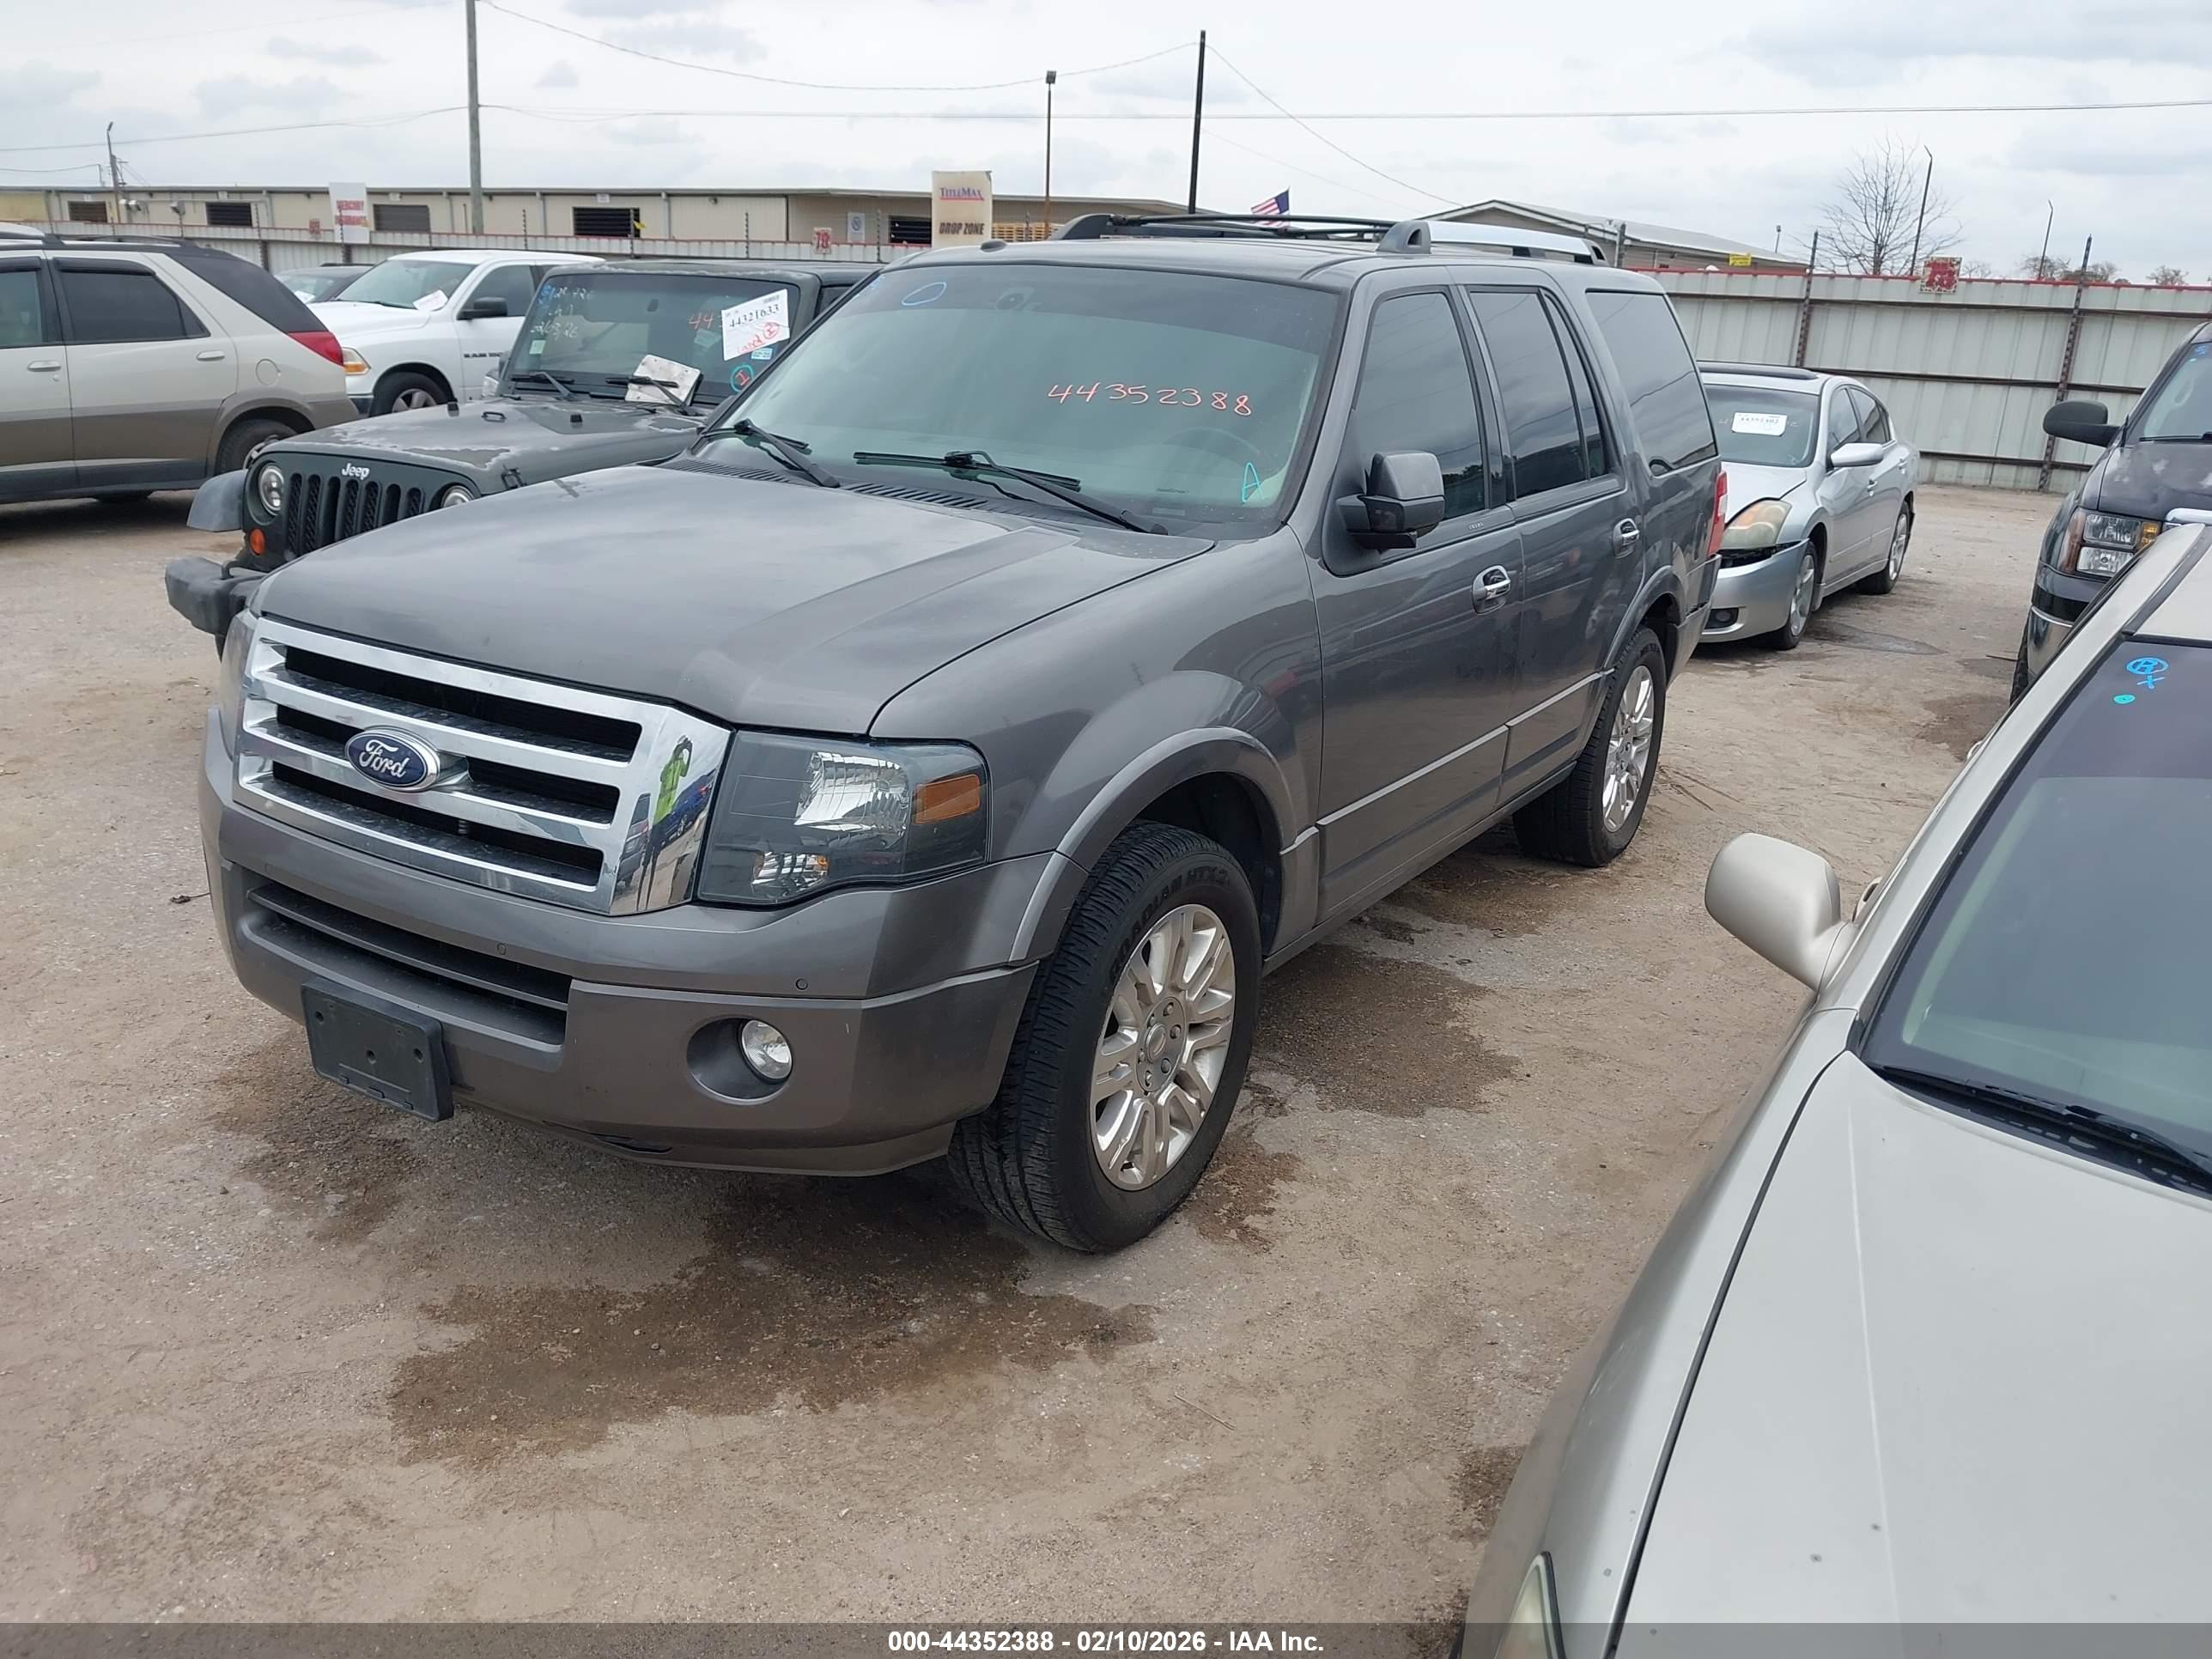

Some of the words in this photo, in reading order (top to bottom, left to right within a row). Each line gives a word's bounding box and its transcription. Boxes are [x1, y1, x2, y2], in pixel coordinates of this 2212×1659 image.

[939, 222, 963, 234] DROP
[963, 222, 984, 234] ZONE
[1048, 382, 1252, 416] 44352388
[342, 462, 370, 480] Jeep
[1243, 462, 1264, 504] A
[359, 739, 410, 778] Ford
